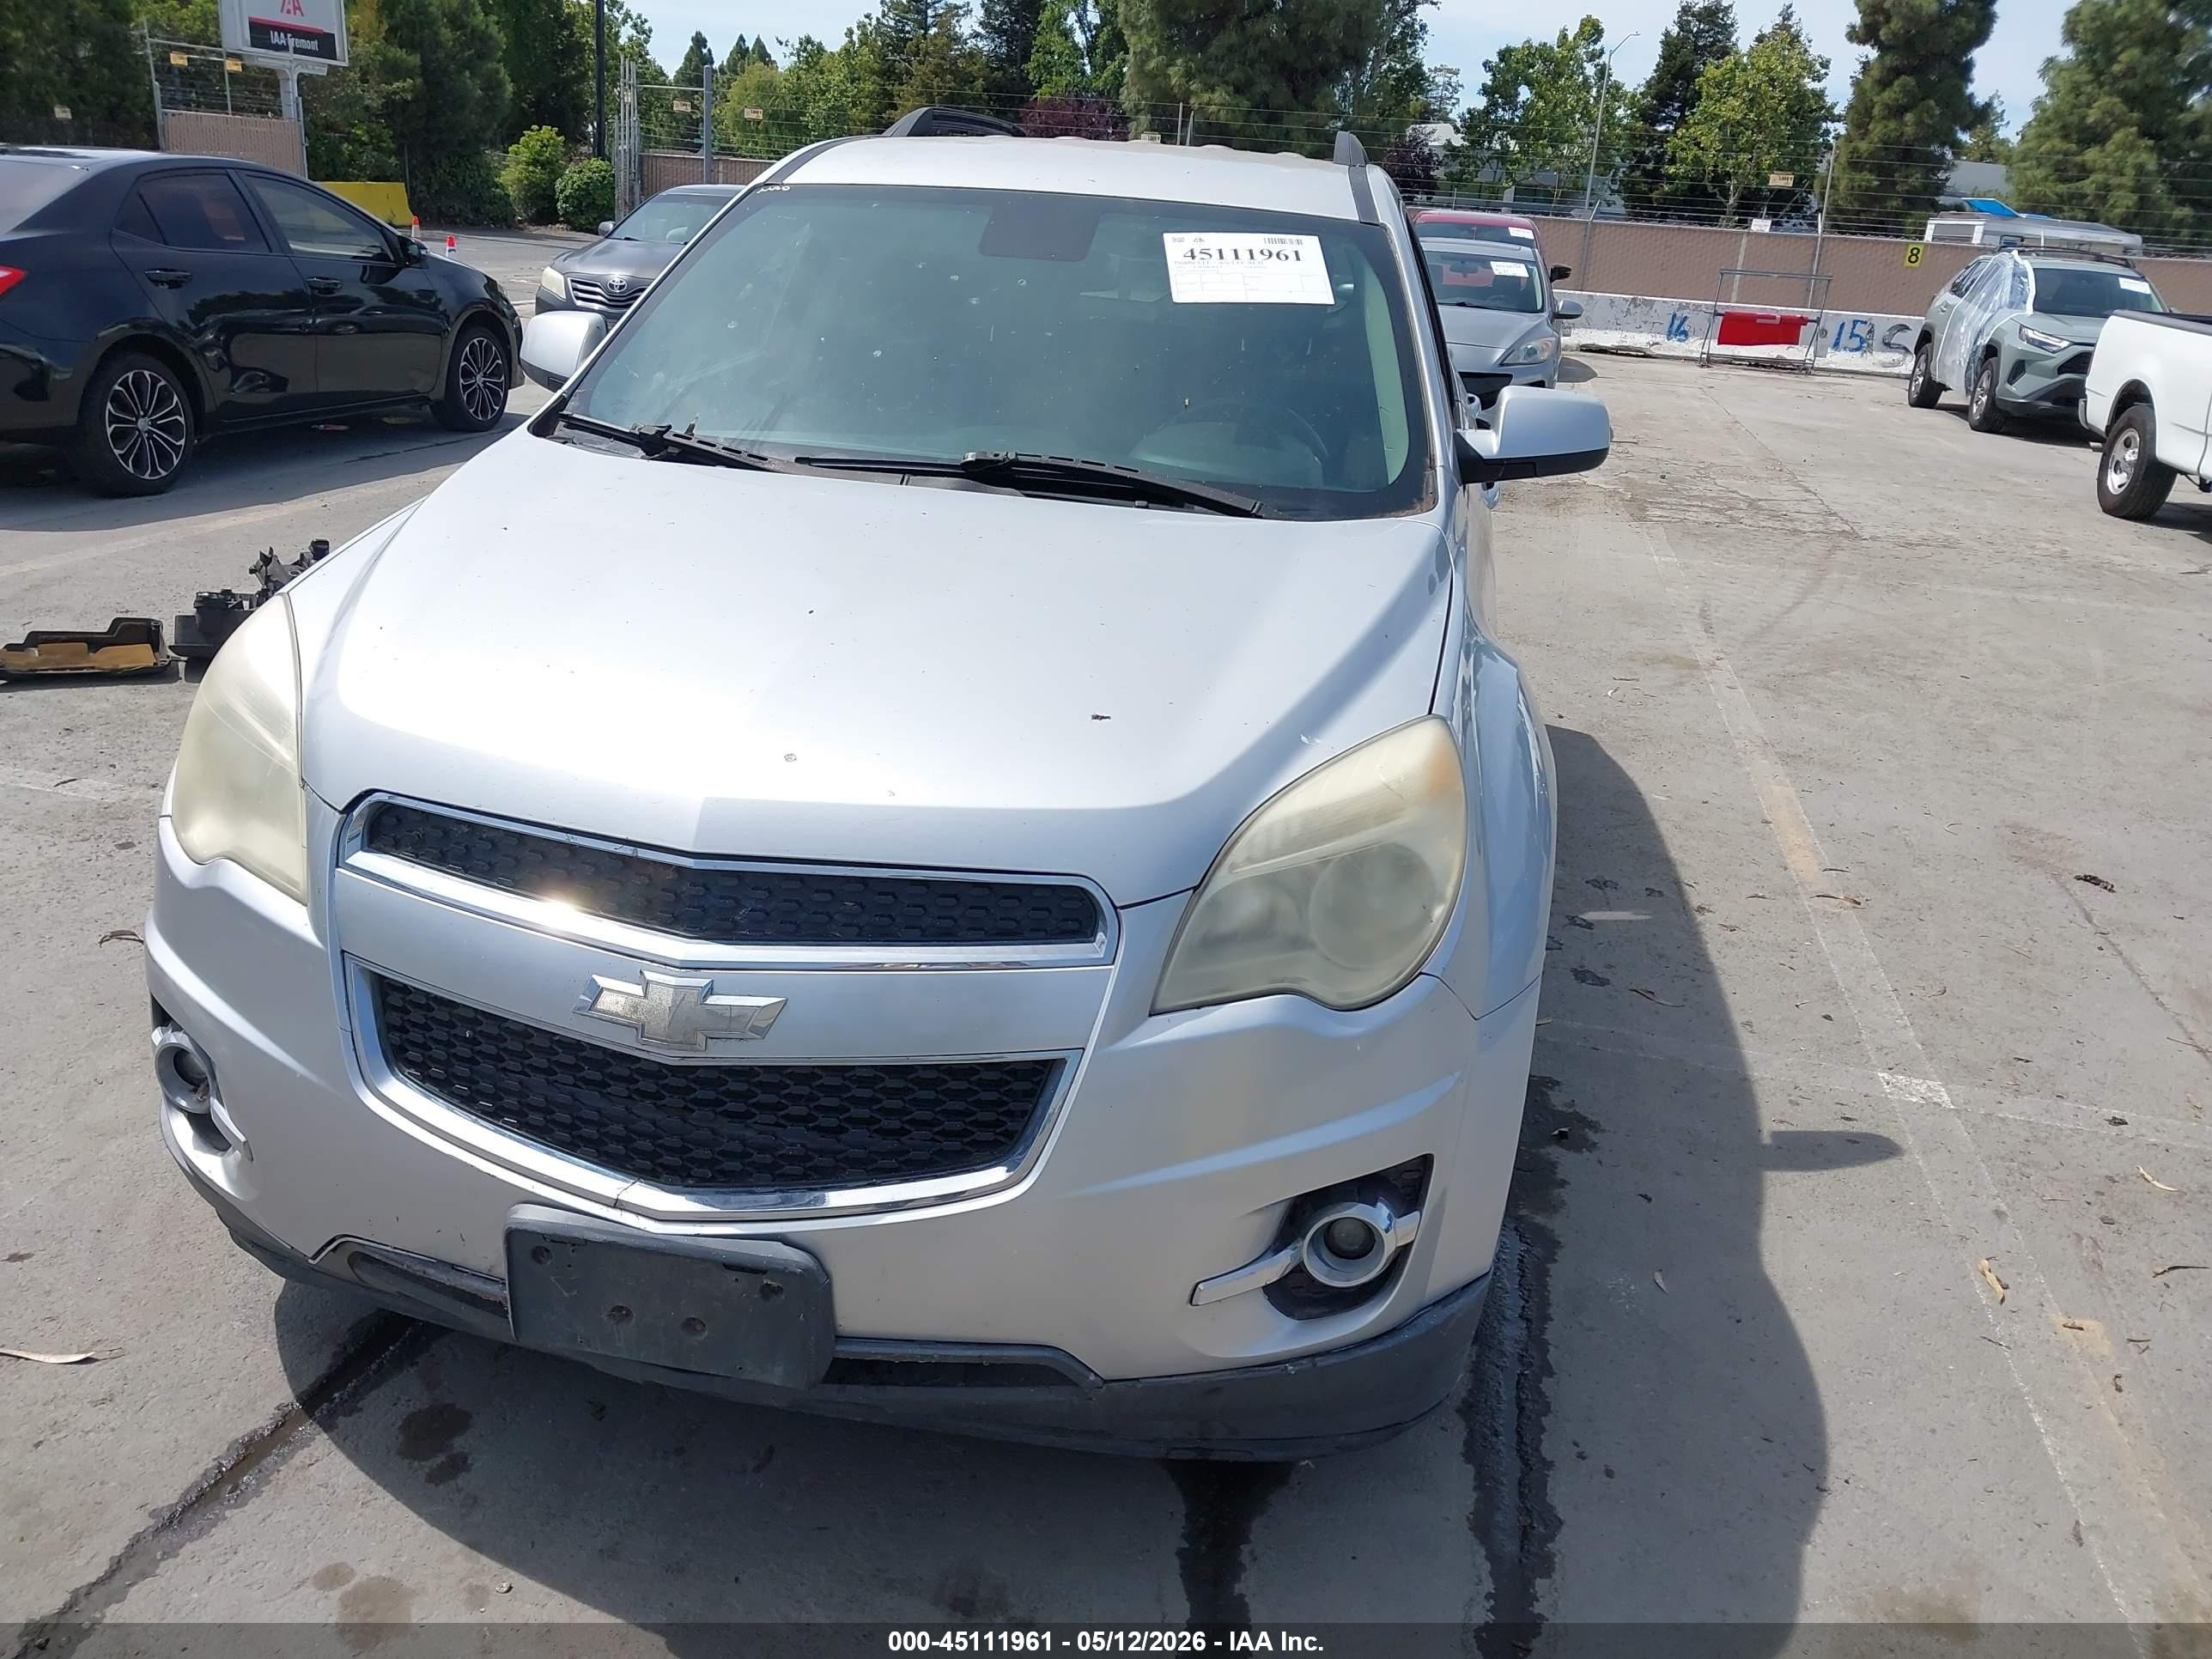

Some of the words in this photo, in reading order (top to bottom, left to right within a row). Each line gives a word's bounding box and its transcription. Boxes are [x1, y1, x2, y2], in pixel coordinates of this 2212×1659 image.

[270, 29, 287, 46] IAA
[287, 33, 319, 52] Fremont
[1182, 247, 1304, 262] 45111961
[1908, 246, 1921, 264] 8
[1832, 319, 1869, 353] 15
